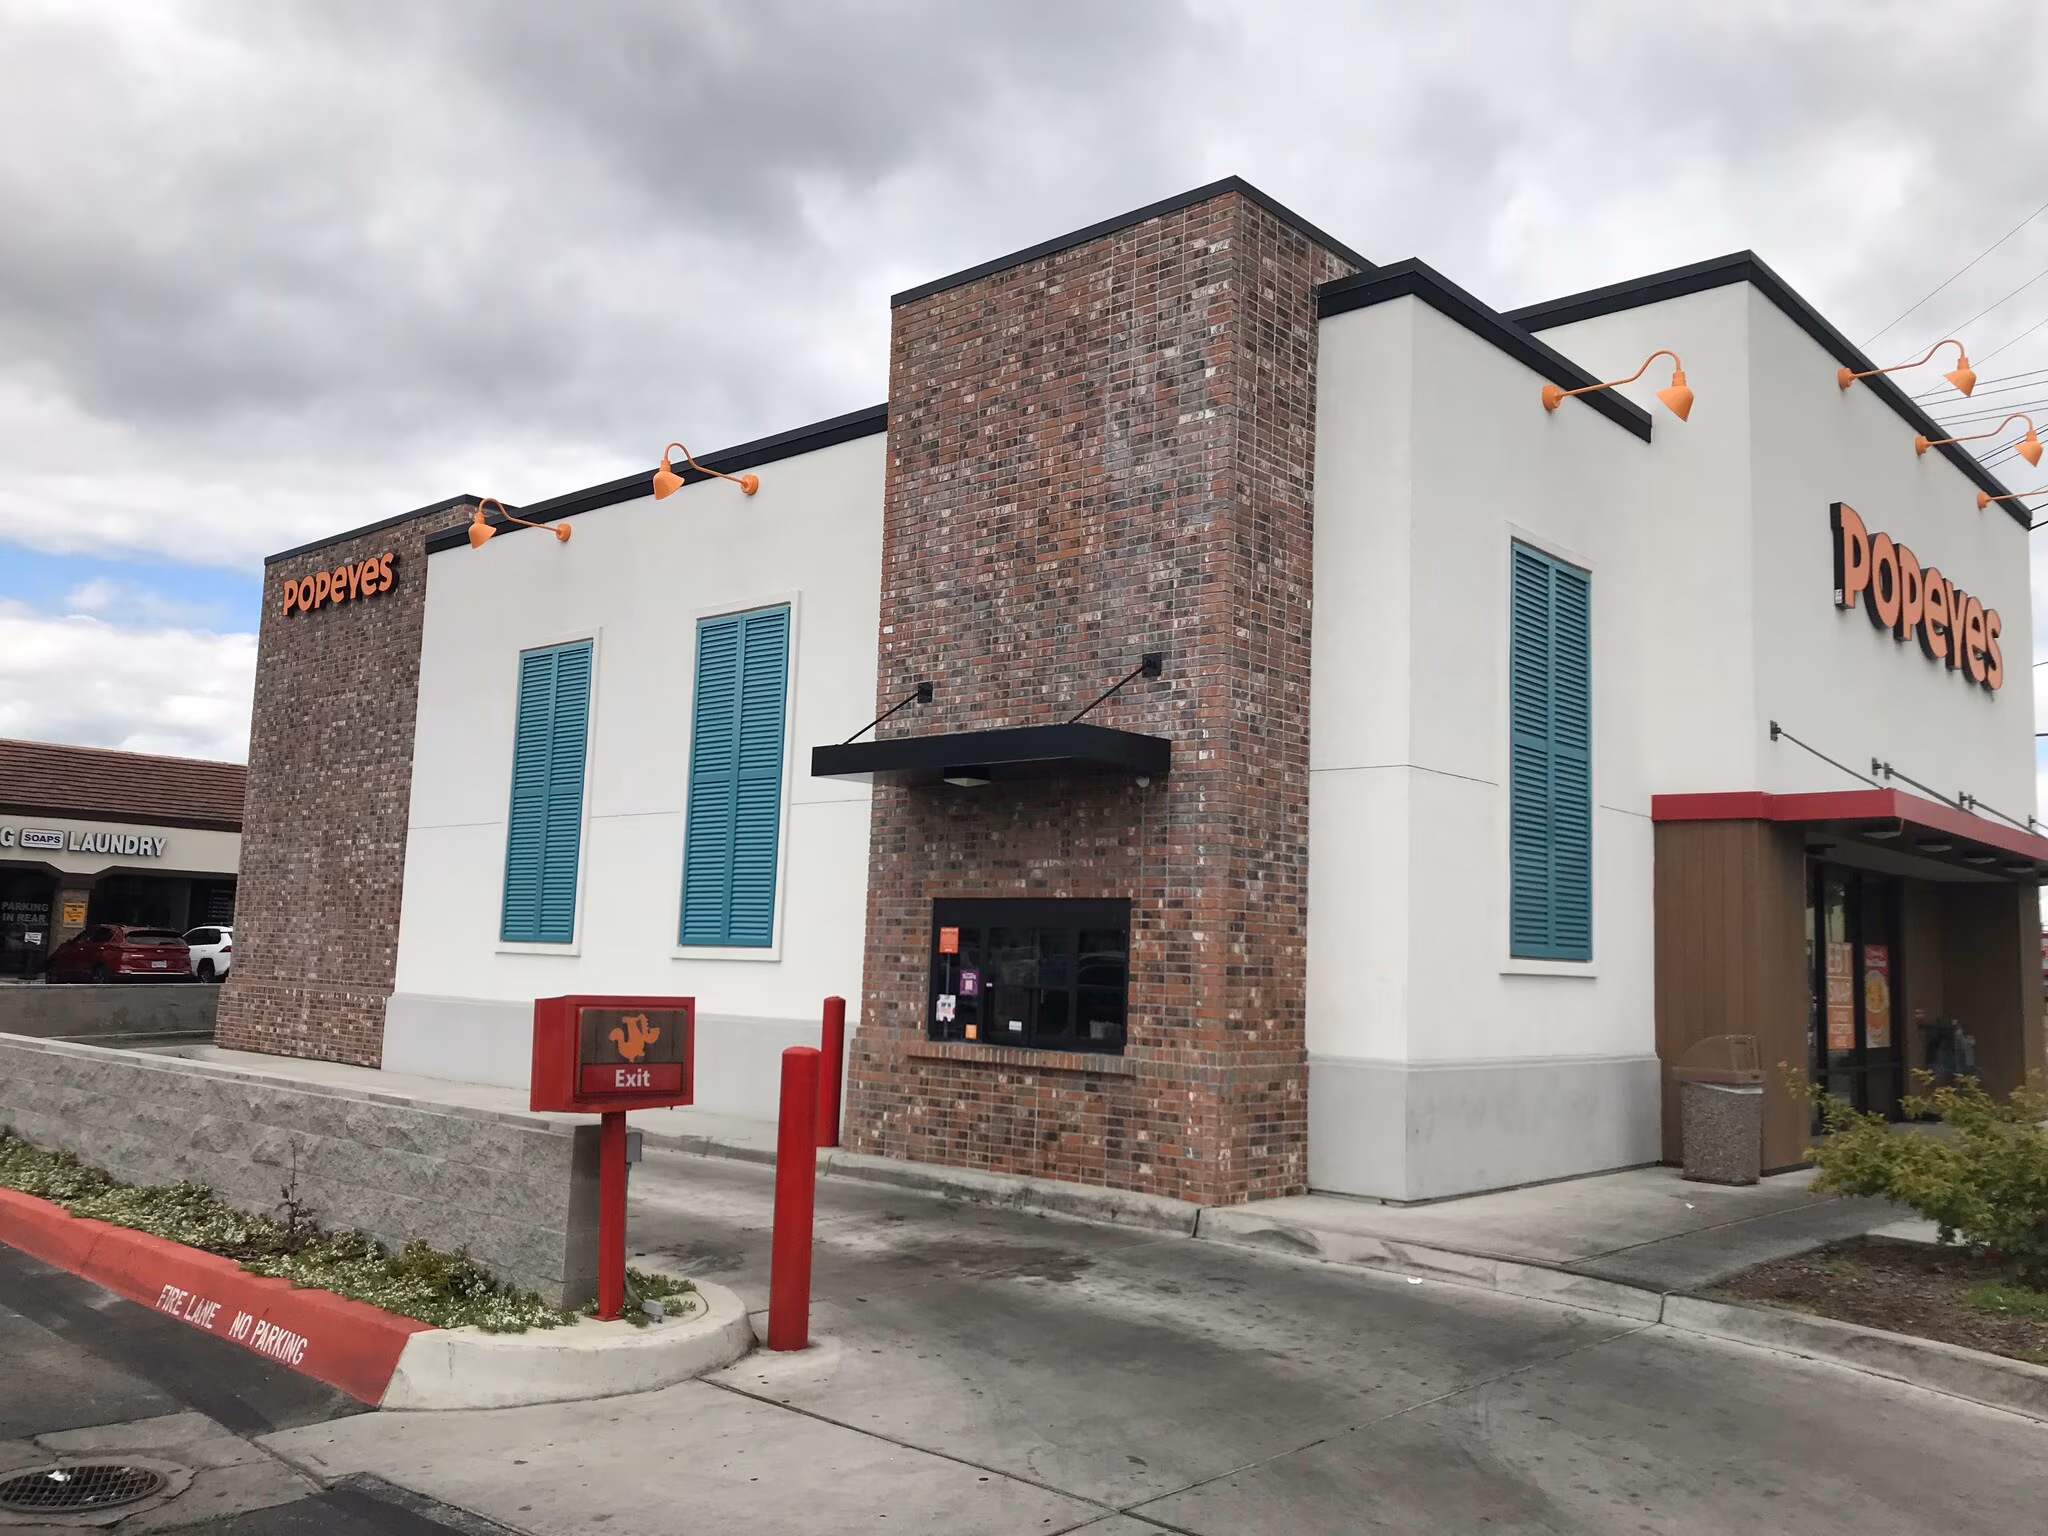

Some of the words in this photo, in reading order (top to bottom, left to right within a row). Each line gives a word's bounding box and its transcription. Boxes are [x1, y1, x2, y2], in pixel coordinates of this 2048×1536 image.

[24, 833, 61, 844] SOAPS
[68, 831, 167, 856] LAUNDRY
[1, 901, 49, 912] PARKING
[2, 912, 14, 922] IN
[17, 913, 46, 923] REAR
[615, 1068, 651, 1088] Exit
[156, 1284, 188, 1315] FIRE
[183, 1295, 221, 1329] LANE
[228, 1311, 253, 1341] NO
[250, 1319, 308, 1365] PARKING
